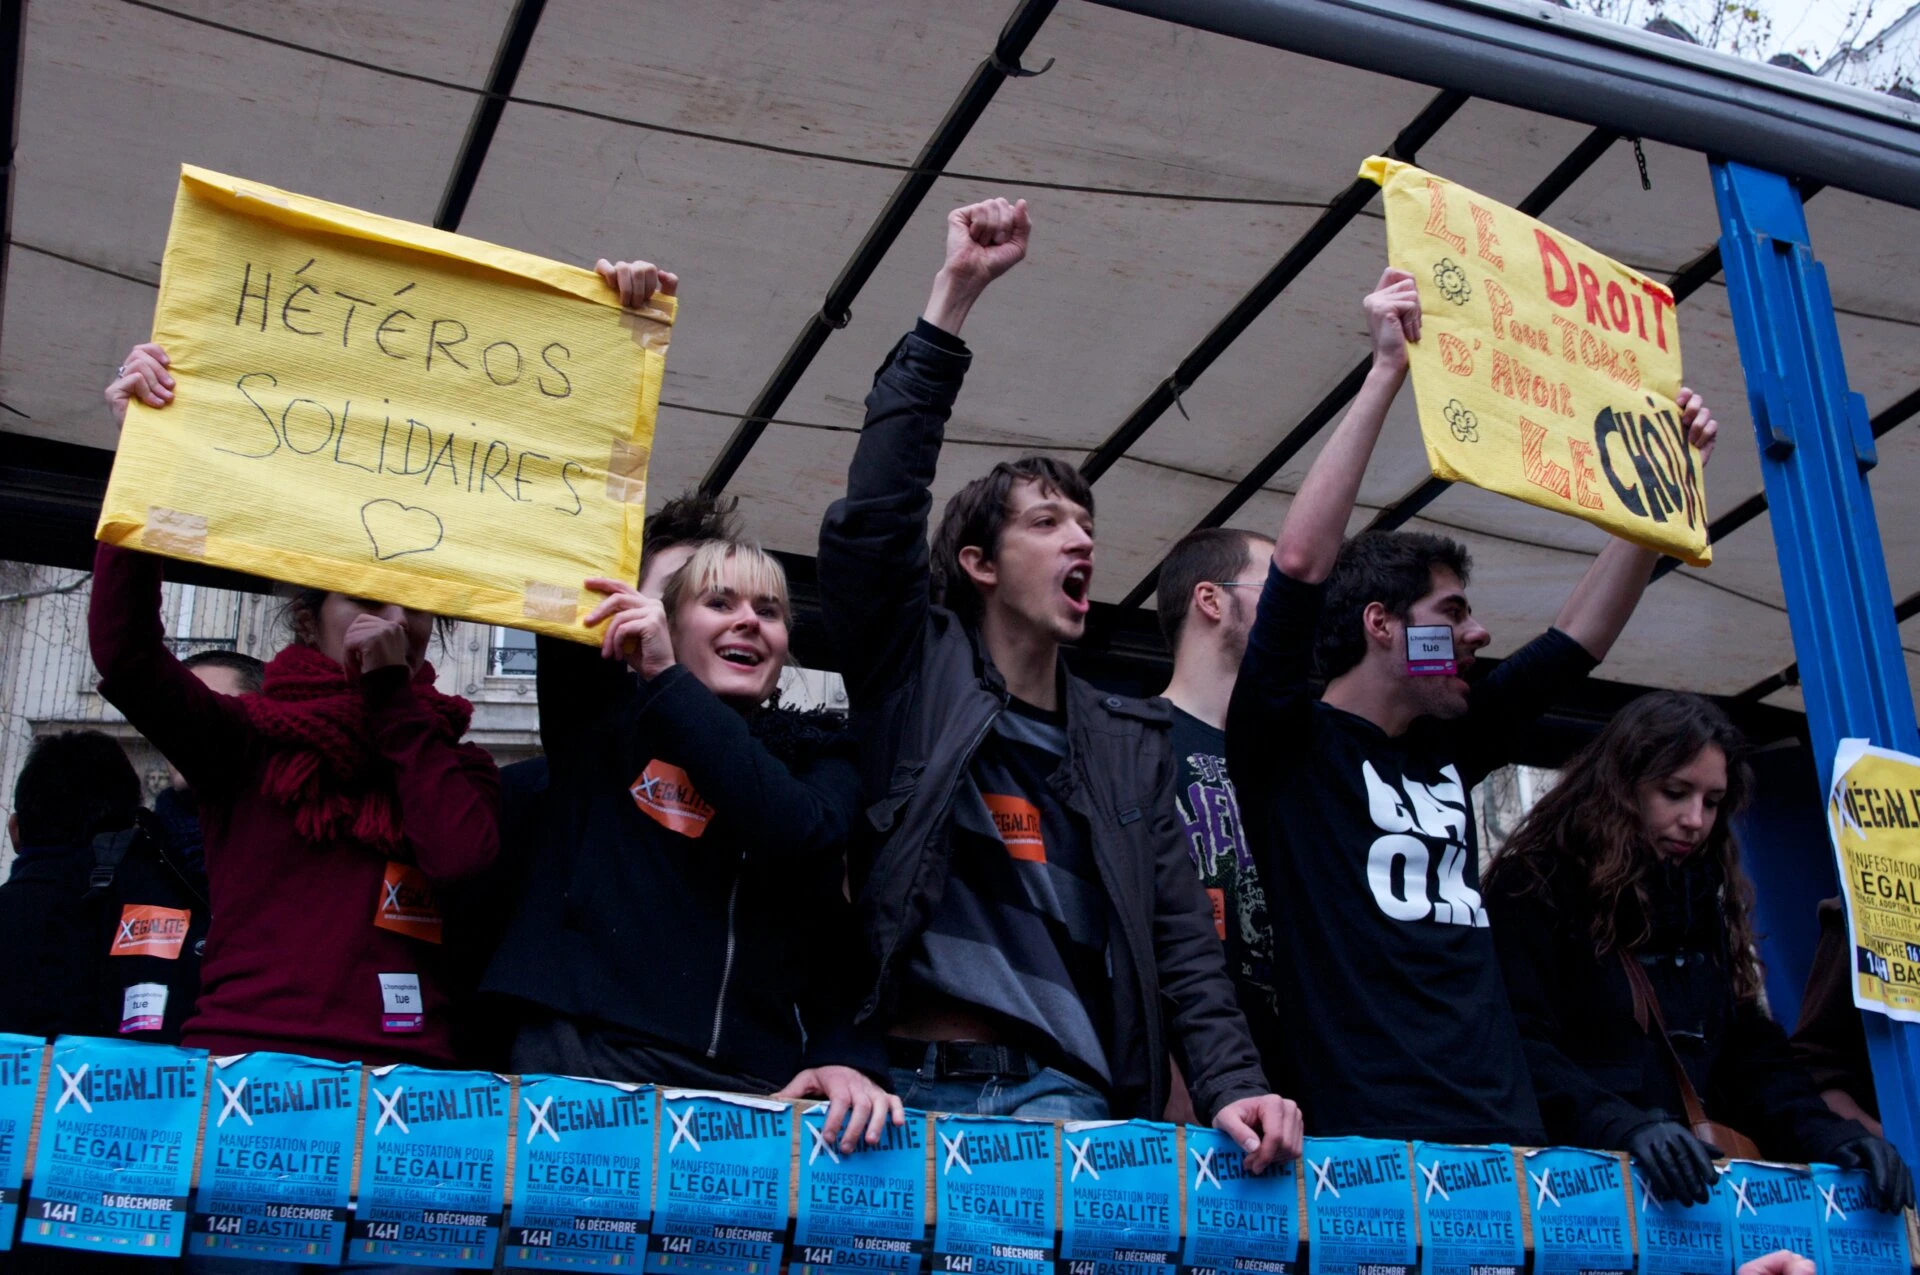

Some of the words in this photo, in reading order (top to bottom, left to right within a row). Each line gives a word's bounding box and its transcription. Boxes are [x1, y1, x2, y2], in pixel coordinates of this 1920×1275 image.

[1424, 178, 1504, 272] LE
[235, 258, 572, 399] HÉTÉROS
[1552, 314, 1642, 391] TOUS
[1520, 416, 1605, 510] LE
[1423, 643, 1440, 652] tue
[132, 1000, 149, 1009] tue
[395, 994, 410, 1004] tue
[56, 1120, 148, 1140] MANIFESTATION
[150, 1129, 182, 1144] POUR
[219, 1134, 307, 1151] MANIFESTATION
[310, 1140, 341, 1153] POUR
[377, 1142, 461, 1158] MANIFESTATION
[465, 1147, 494, 1161] POUR
[529, 1150, 609, 1166] MANIFESTATION
[613, 1155, 640, 1169] POUR
[671, 1159, 749, 1177] MANIFESTATION
[752, 1166, 779, 1179] POUR
[812, 1171, 885, 1188] MANIFESTATION
[889, 1177, 914, 1190] POUR
[46, 1186, 100, 1204] DIMANCHE
[102, 1194, 114, 1206] 16
[116, 1195, 173, 1210] DÉCEMBRE
[946, 1181, 1016, 1198] MANIFESTATION
[1019, 1187, 1044, 1200] POUR
[1075, 1188, 1143, 1202] MANIFESTATION
[1146, 1192, 1169, 1204] POUR
[43, 1202, 78, 1222] 14H
[82, 1208, 172, 1230] BASTILLE
[211, 1201, 263, 1215] DIMANCHE
[266, 1206, 278, 1217] 16
[280, 1206, 334, 1220] DÉCEMBRE
[370, 1208, 421, 1221] DIMANCHE
[423, 1212, 434, 1223] 16
[436, 1212, 488, 1226] DÉCEMBRE
[209, 1216, 242, 1233] 14H
[246, 1220, 334, 1239] BASTILLE
[368, 1222, 400, 1239] 14H
[404, 1226, 488, 1244] BASTILLE
[524, 1215, 572, 1228] DIMANCHE
[575, 1219, 585, 1229] 16
[587, 1219, 637, 1232] DÉCEMBRE
[665, 1222, 711, 1236] DIMANCHE
[714, 1227, 724, 1238] 16
[726, 1227, 773, 1242] DÉCEMBRE
[522, 1229, 553, 1246] 14H
[557, 1232, 637, 1251] BASTILLE
[663, 1236, 692, 1253] 14H
[696, 1240, 773, 1260] BASTILLE
[807, 1234, 851, 1246] DIMANCHE
[854, 1238, 864, 1248] 16
[865, 1238, 911, 1252] DÉCEMBRE
[805, 1247, 833, 1264] 14H
[837, 1251, 911, 1269] BASTILLE
[947, 1241, 989, 1254] DIMANCHE
[991, 1246, 1000, 1256] 16
[1002, 1246, 1044, 1260] DÉCEMBRE
[1115, 1251, 1123, 1260] 16
[1125, 1251, 1166, 1263] DÉCEMBRE
[946, 1255, 973, 1271] 14H
